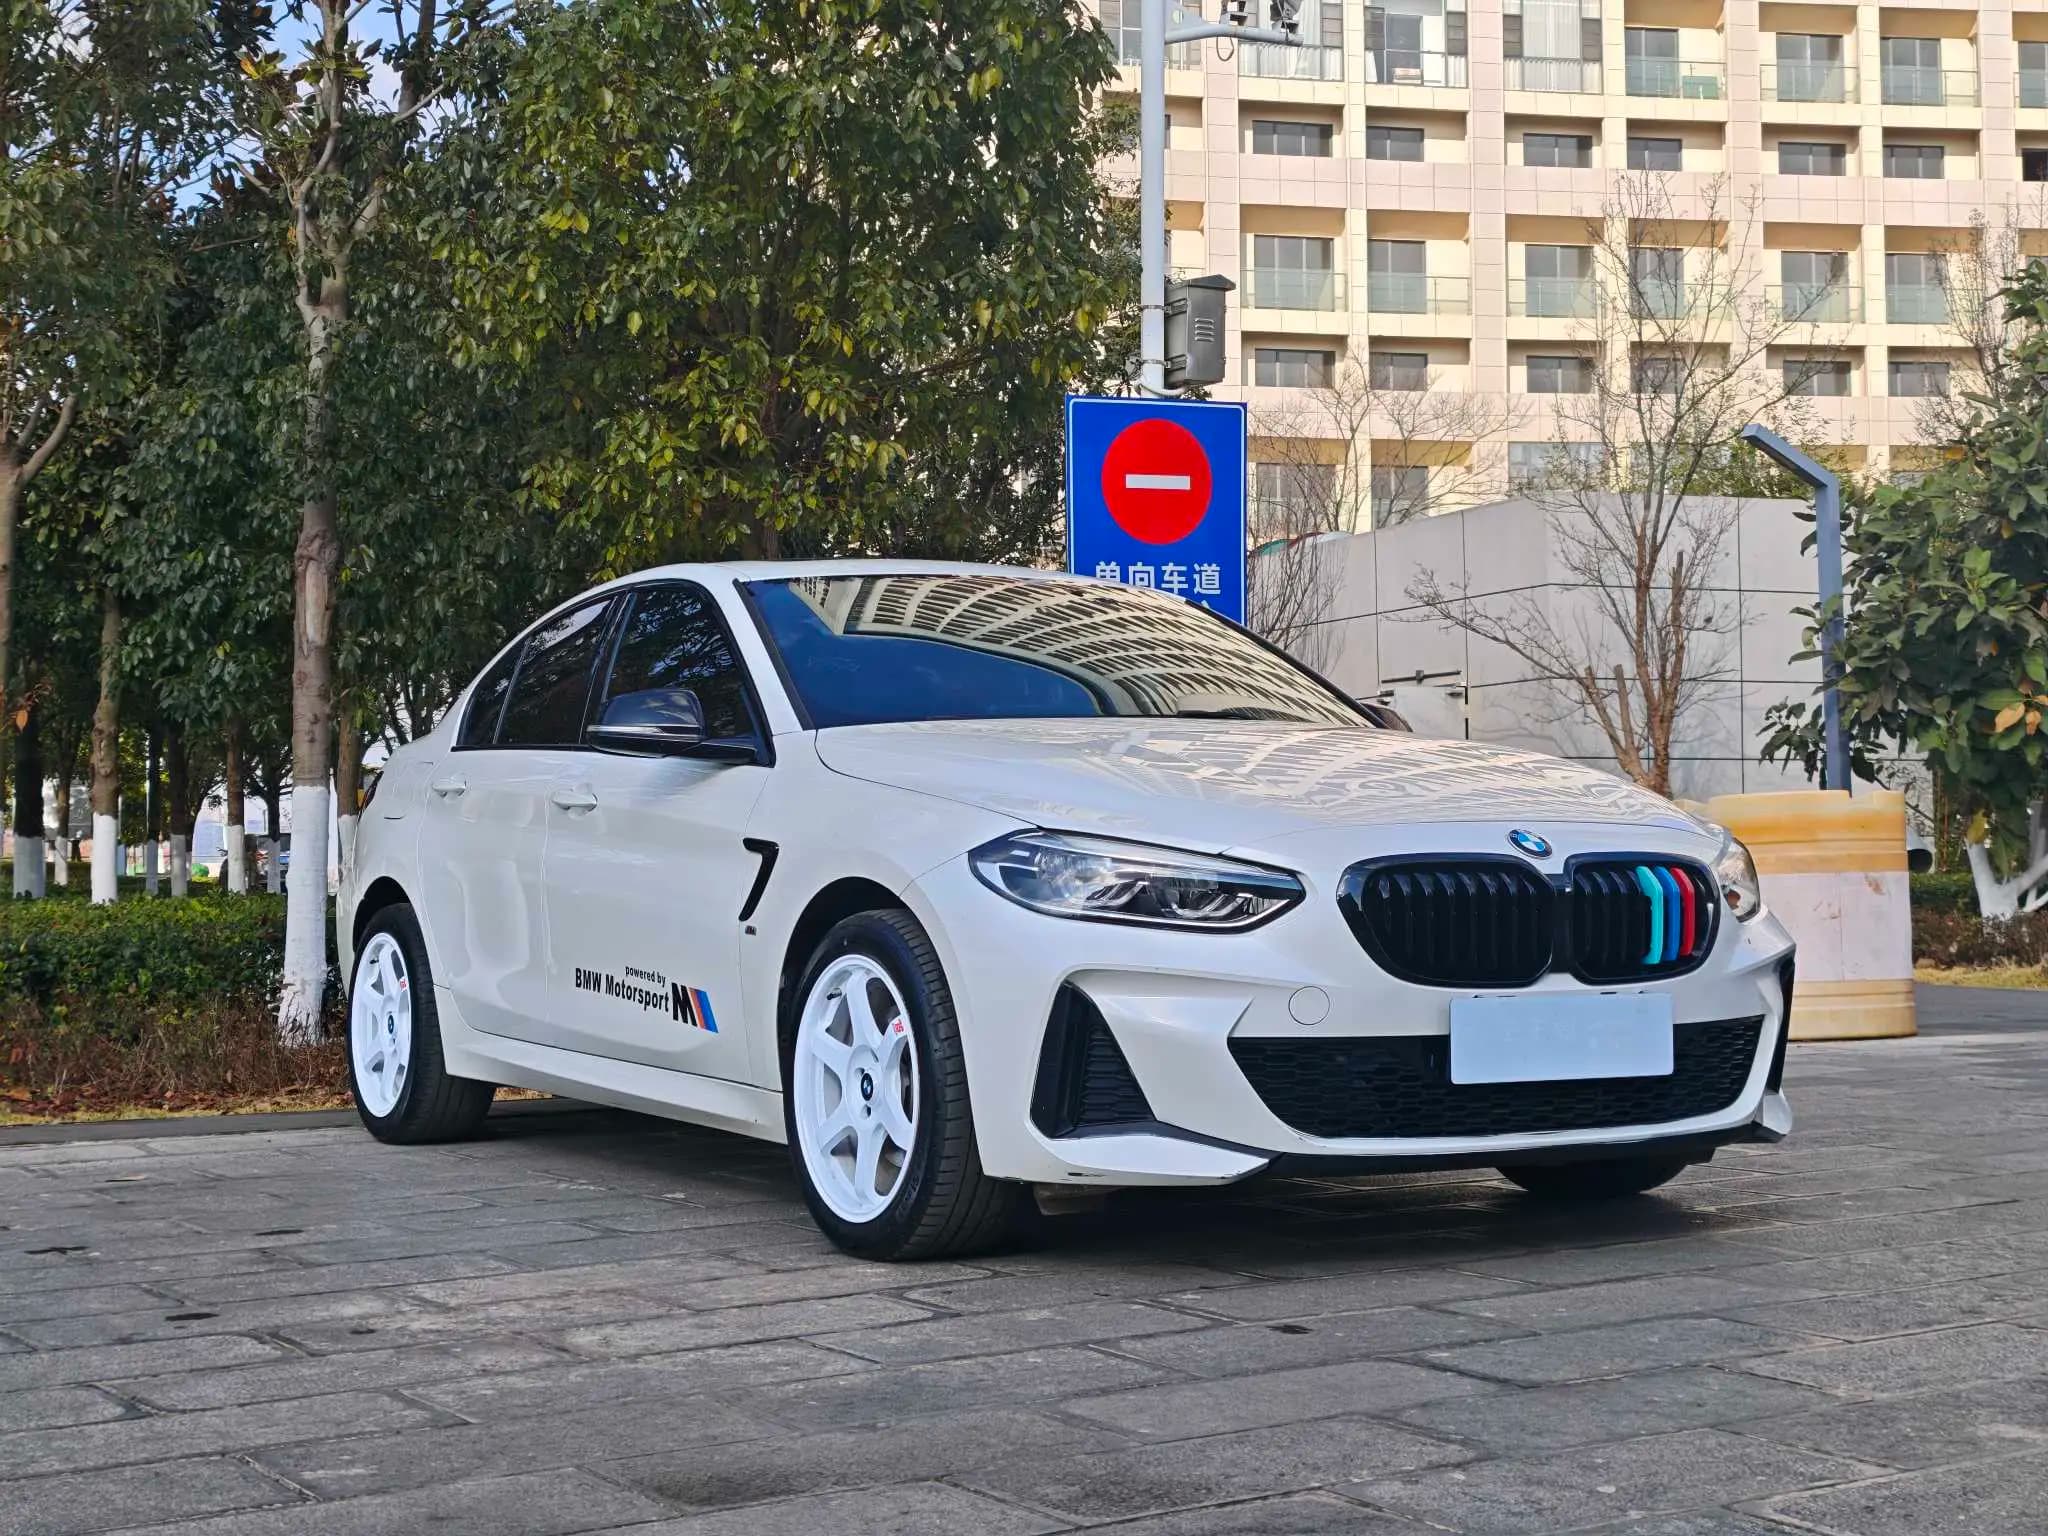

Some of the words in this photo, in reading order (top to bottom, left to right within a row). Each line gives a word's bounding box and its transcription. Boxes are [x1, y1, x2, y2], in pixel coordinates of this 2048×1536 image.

[575, 967, 602, 994] BMW
[605, 973, 670, 1012] Motorsport
[671, 982, 698, 1027] M
[625, 966, 656, 983] powered
[656, 972, 666, 988] by
